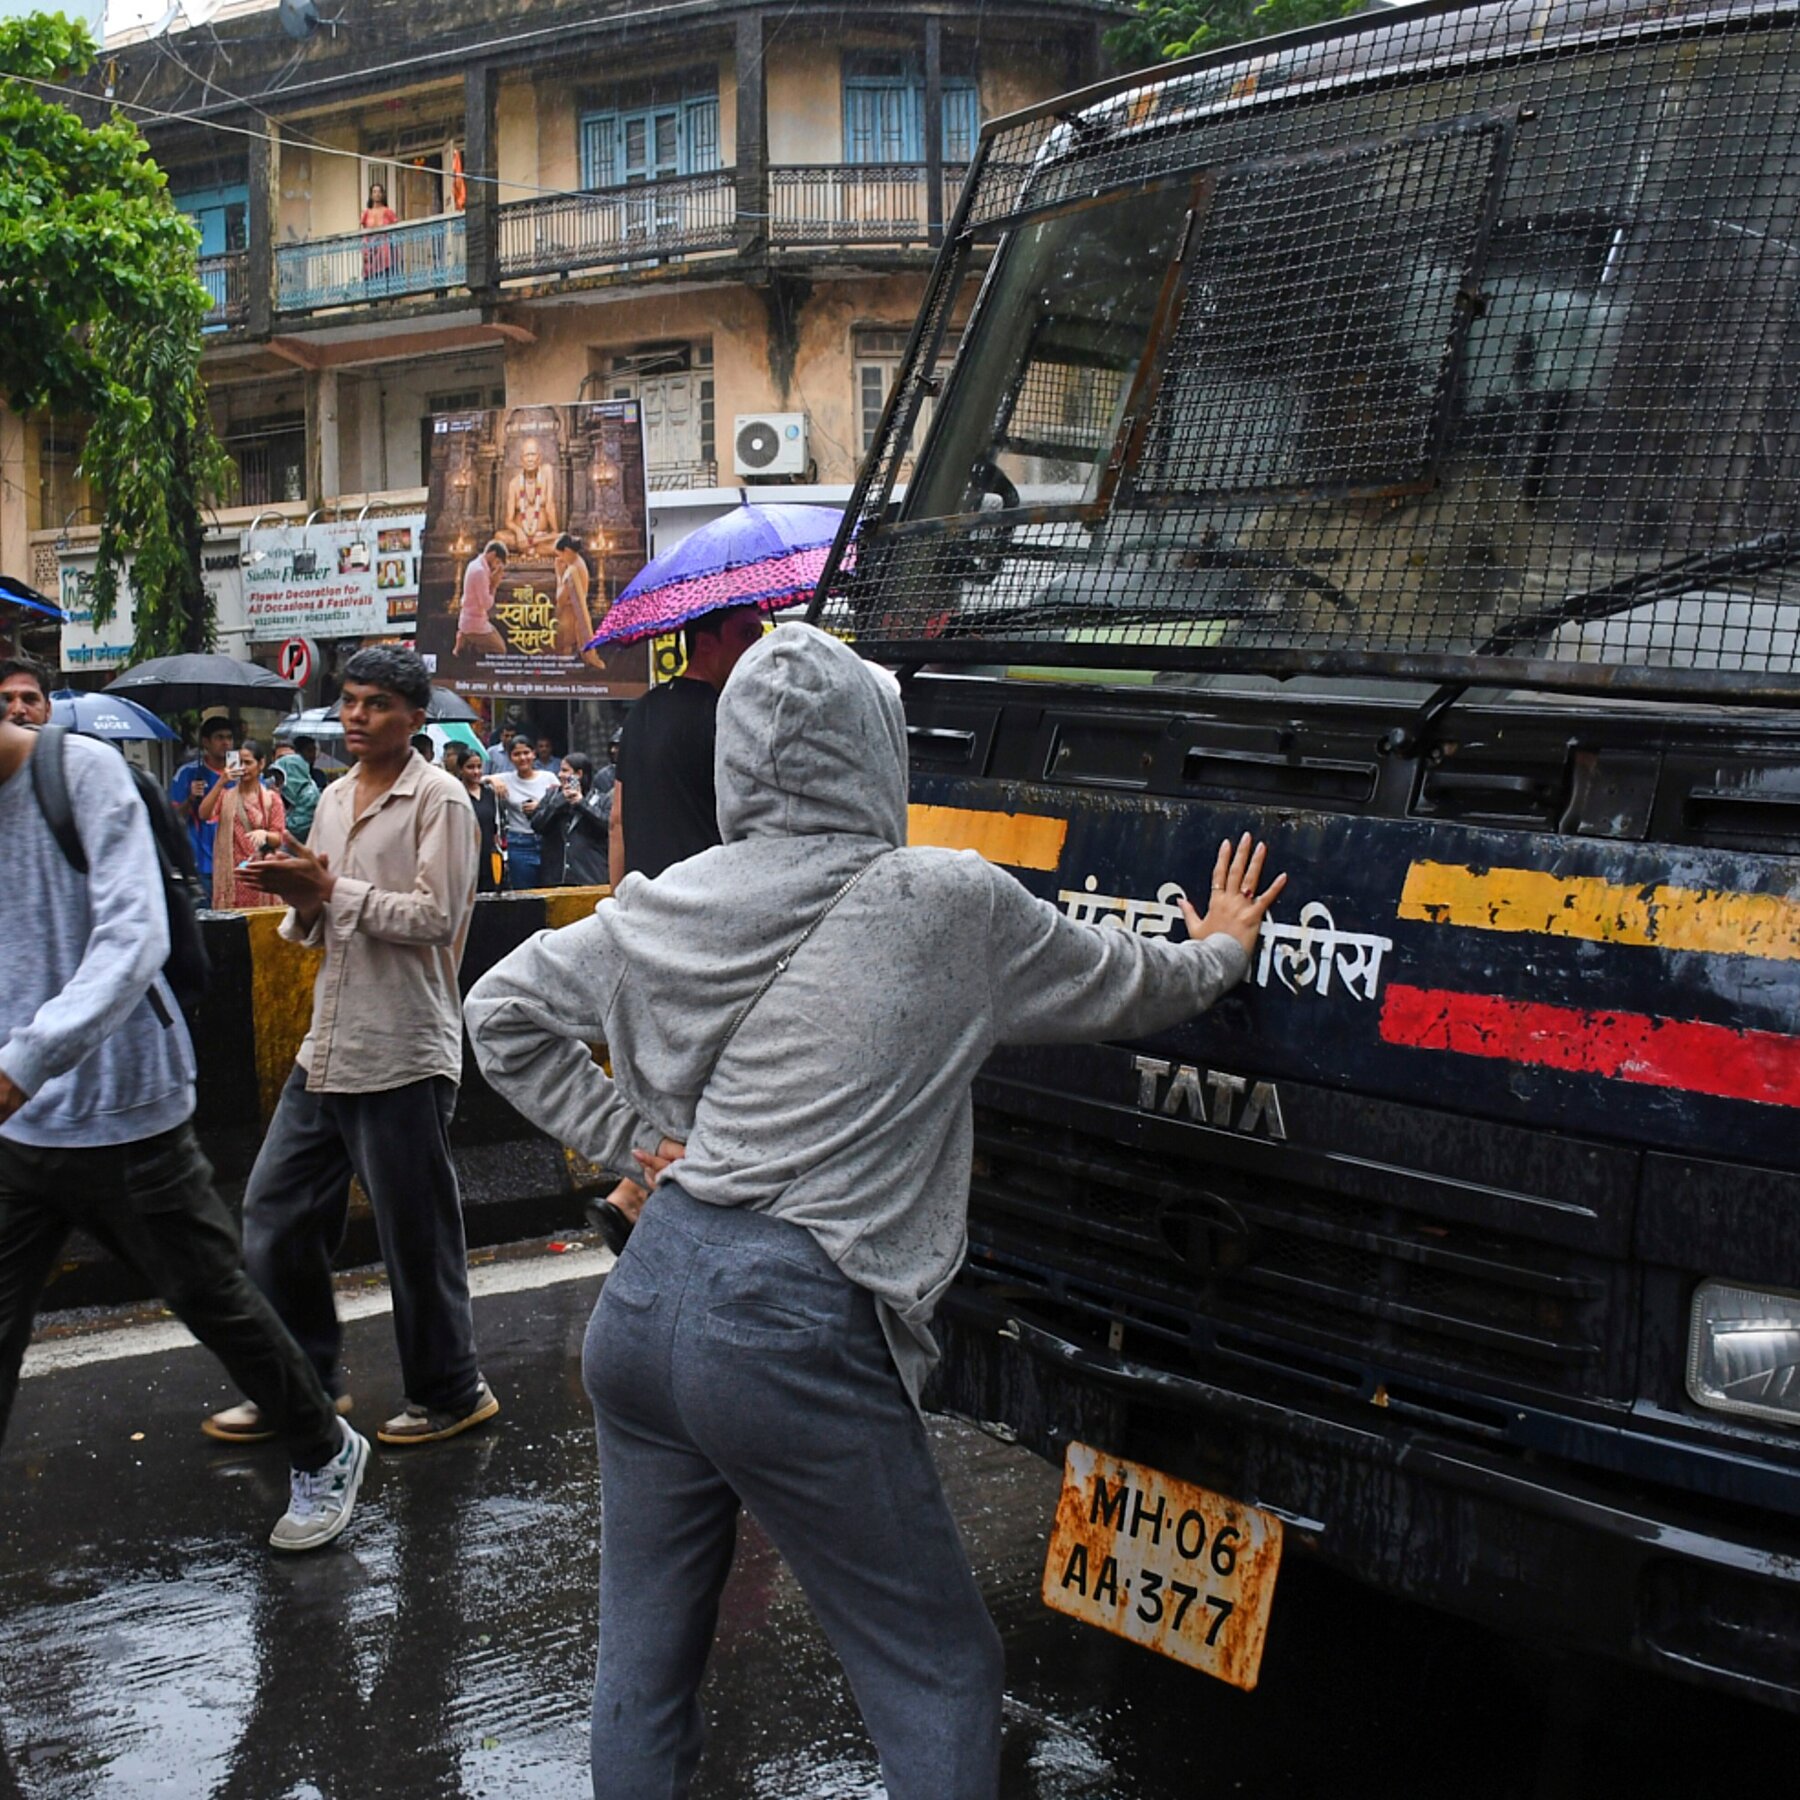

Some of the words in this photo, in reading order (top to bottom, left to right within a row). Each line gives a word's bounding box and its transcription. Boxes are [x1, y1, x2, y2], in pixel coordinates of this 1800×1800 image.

[248, 602, 263, 615] All
[264, 599, 315, 613] Occasions
[326, 595, 373, 608] Festivals
[250, 591, 283, 602] Flower
[285, 586, 344, 600] Decoration
[345, 584, 360, 595] for
[495, 592, 554, 630] स्वामी
[507, 617, 559, 655] समर्थ
[288, 645, 303, 681] P
[1131, 1055, 1288, 1140] TATA
